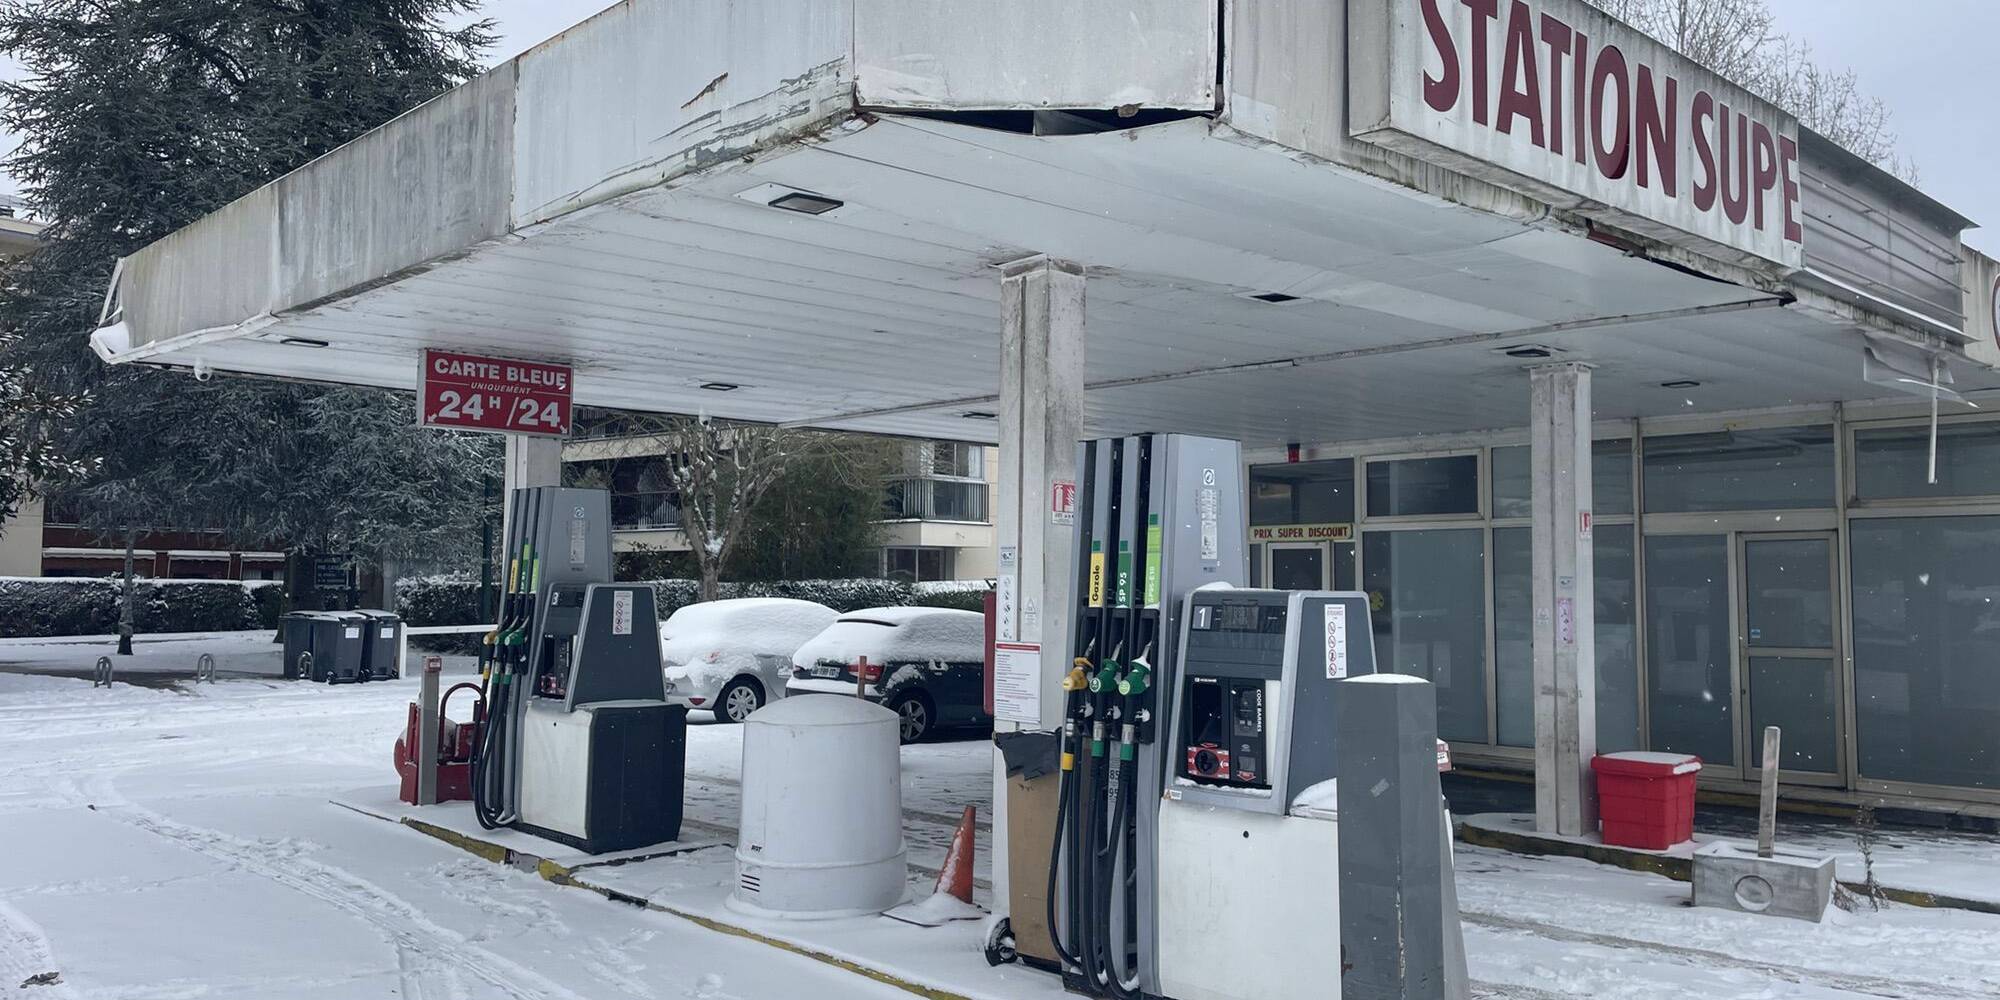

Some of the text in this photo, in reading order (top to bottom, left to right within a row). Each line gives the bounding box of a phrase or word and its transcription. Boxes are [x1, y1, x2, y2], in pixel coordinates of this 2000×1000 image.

[1420, 0, 1802, 244] STATION SUPE
[434, 358, 567, 387] CARTE BLEUE
[470, 382, 532, 396] UNIQUEMENT
[1254, 527, 1348, 538] PRIX SUPER DISCOUNT
[1092, 565, 1101, 601] Gazole
[1119, 572, 1127, 602] SP 95
[551, 592, 559, 605] 3
[1199, 607, 1206, 628] 1
